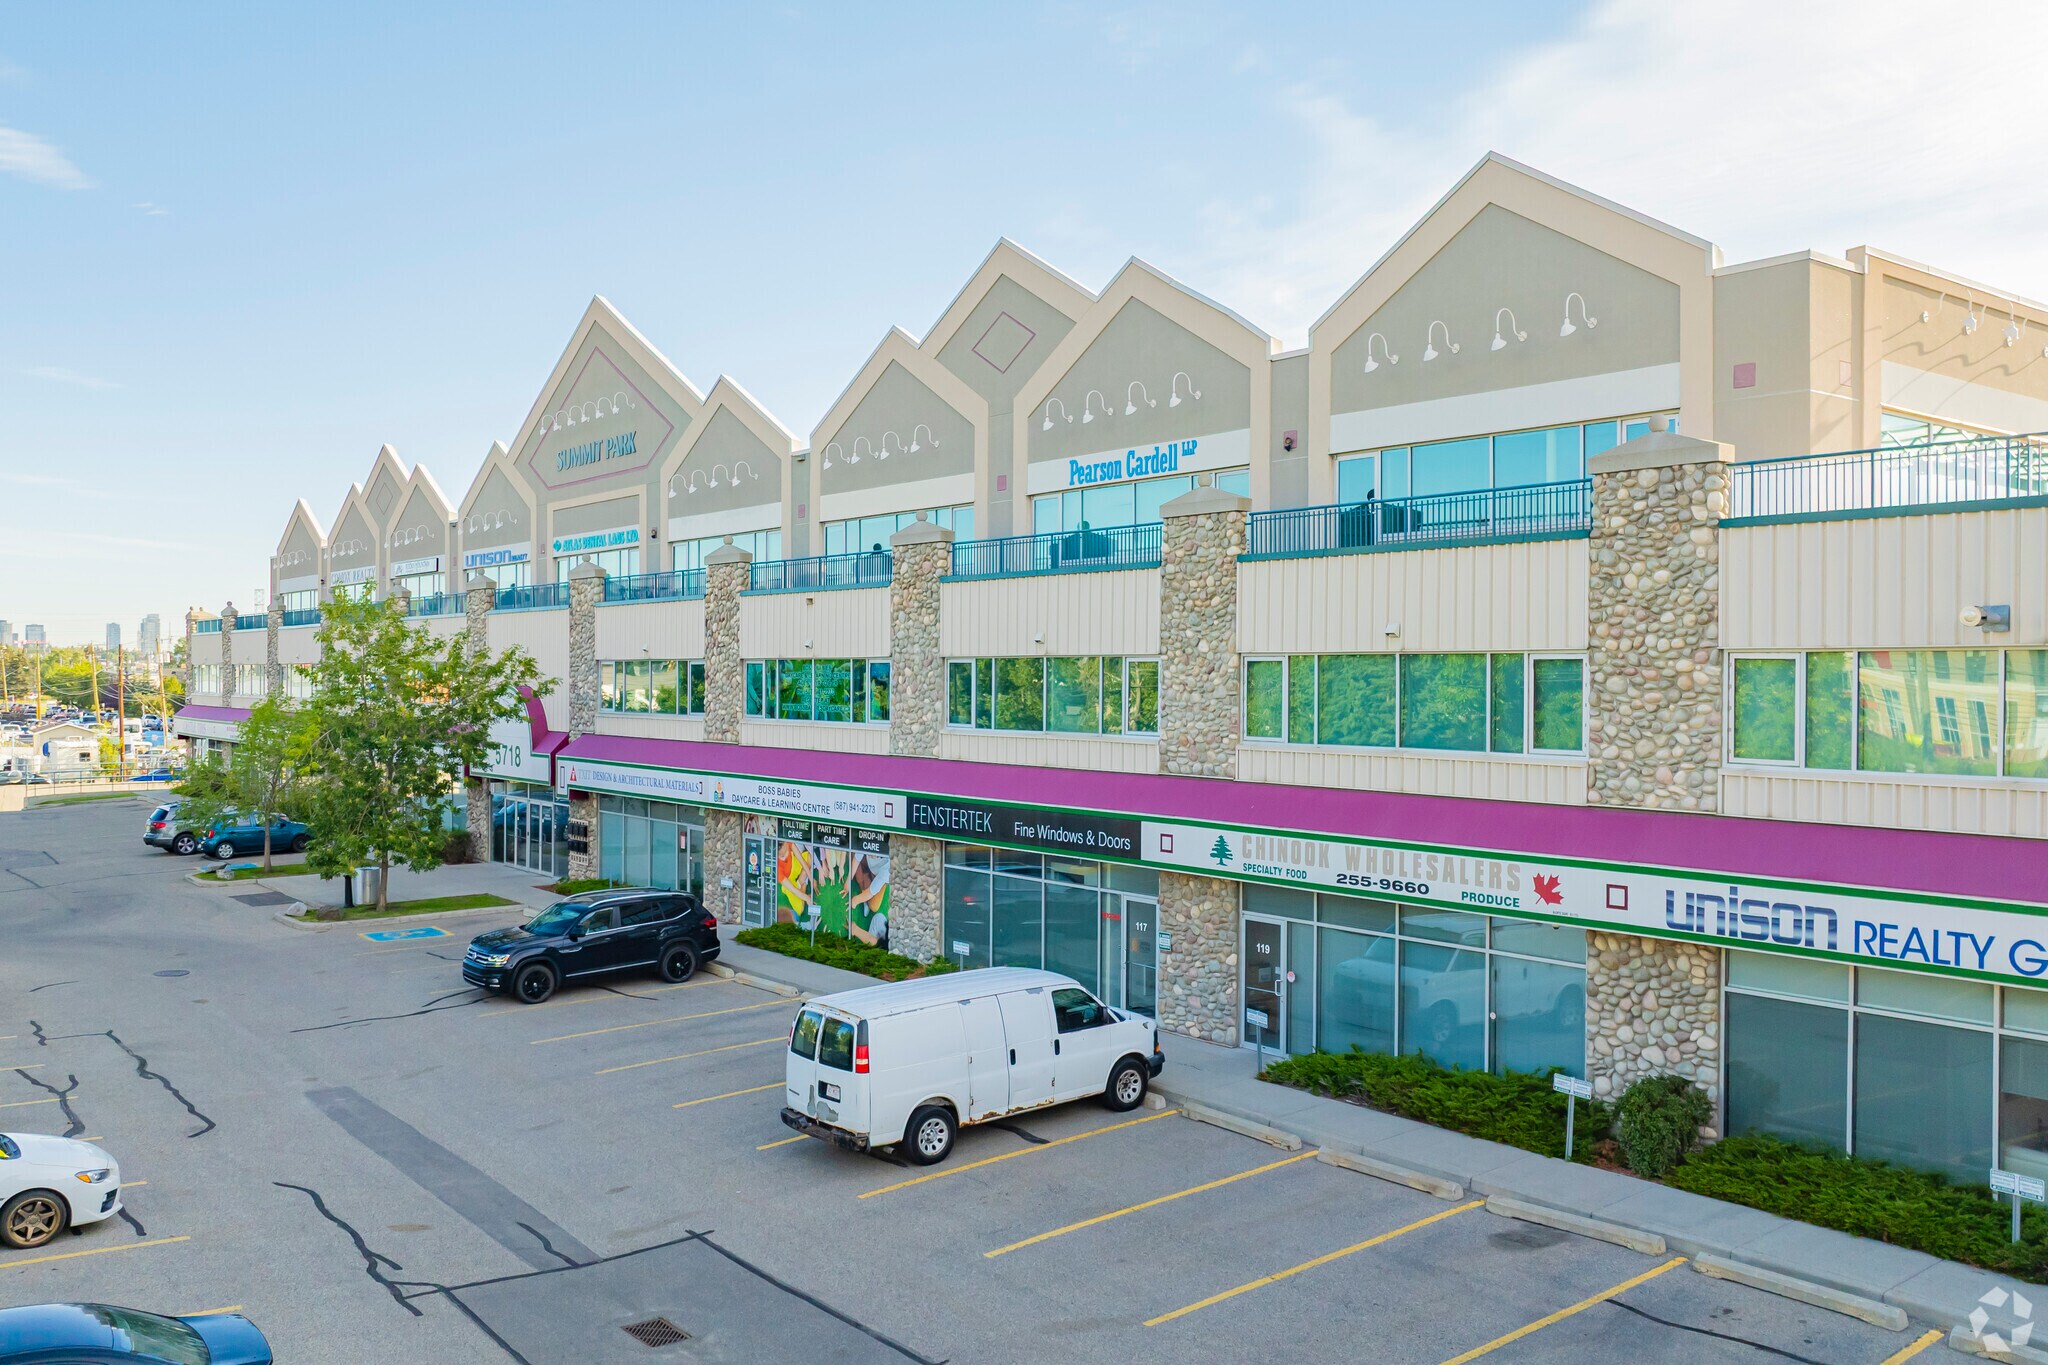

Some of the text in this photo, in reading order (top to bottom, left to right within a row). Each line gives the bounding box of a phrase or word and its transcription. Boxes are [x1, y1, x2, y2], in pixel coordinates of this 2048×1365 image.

[557, 431, 636, 472] SUMMIT PARK
[1069, 439, 1198, 486] Pearson Cardell LLP
[495, 744, 521, 767] 5718
[593, 771, 612, 781] DESIGN
[613, 774, 617, 782] &
[618, 774, 664, 788] ARCHITECTURAL
[665, 779, 698, 793] MATERIALS
[758, 785, 801, 798] BOSS BABIES
[731, 794, 830, 814] DAYCARE & LEARNING CENTRE
[833, 801, 875, 814] (587) 941-2273
[783, 820, 809, 830] FULL TIME
[913, 804, 992, 833] FENSTERTEK
[788, 830, 802, 839] CARE
[817, 825, 847, 836] PART TIME
[859, 831, 884, 842] DROP-IN
[1014, 822, 1131, 850] Fine Windows & Doors
[824, 836, 840, 845] CARE
[863, 842, 880, 852] CARE
[1241, 835, 1521, 892] CHINOOK WHOLESALERS
[1243, 863, 1307, 880] SPECIALTY FOOD
[1336, 873, 1430, 895] 255-9660
[1461, 891, 1521, 908] PRODUCE
[1136, 922, 1147, 931] 117
[1256, 943, 1270, 954] 119
[1854, 920, 1996, 969] REALTY
